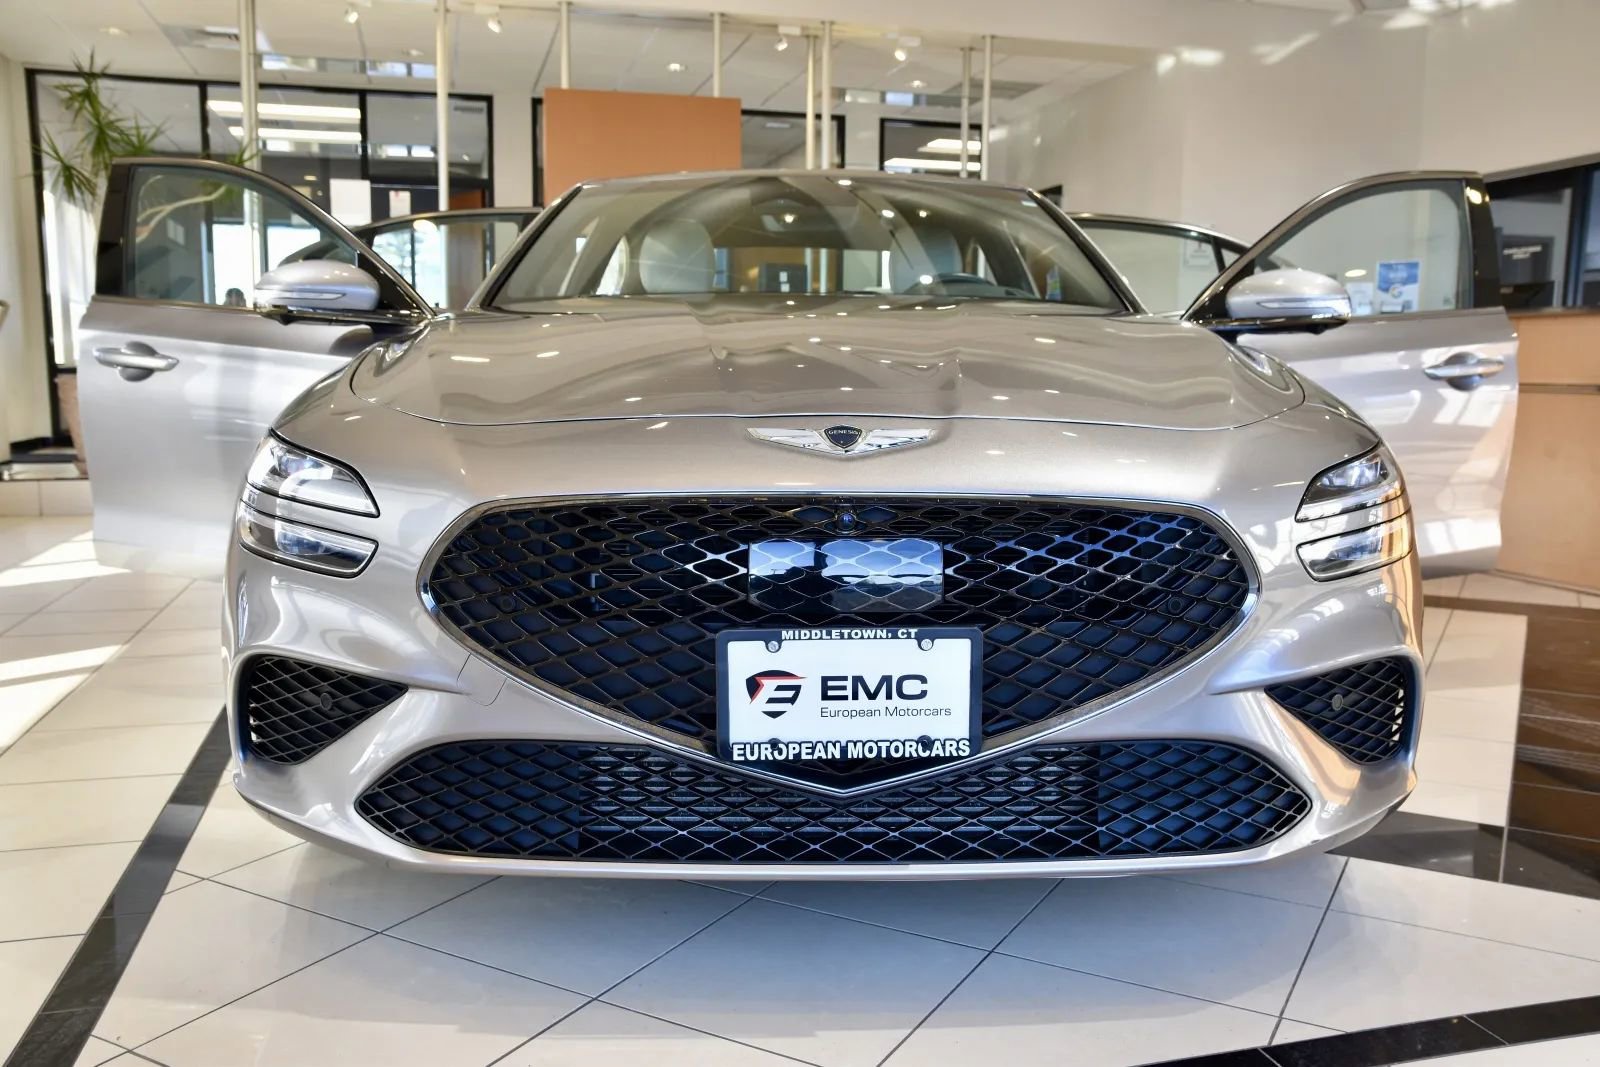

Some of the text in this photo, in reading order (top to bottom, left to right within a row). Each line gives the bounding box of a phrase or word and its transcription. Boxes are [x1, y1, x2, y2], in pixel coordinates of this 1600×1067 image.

[781, 628, 918, 640] MIDDLETOWN, CT
[820, 674, 929, 701] EMC
[820, 706, 952, 720] European Motorcars
[732, 742, 841, 761] EUROPEAN
